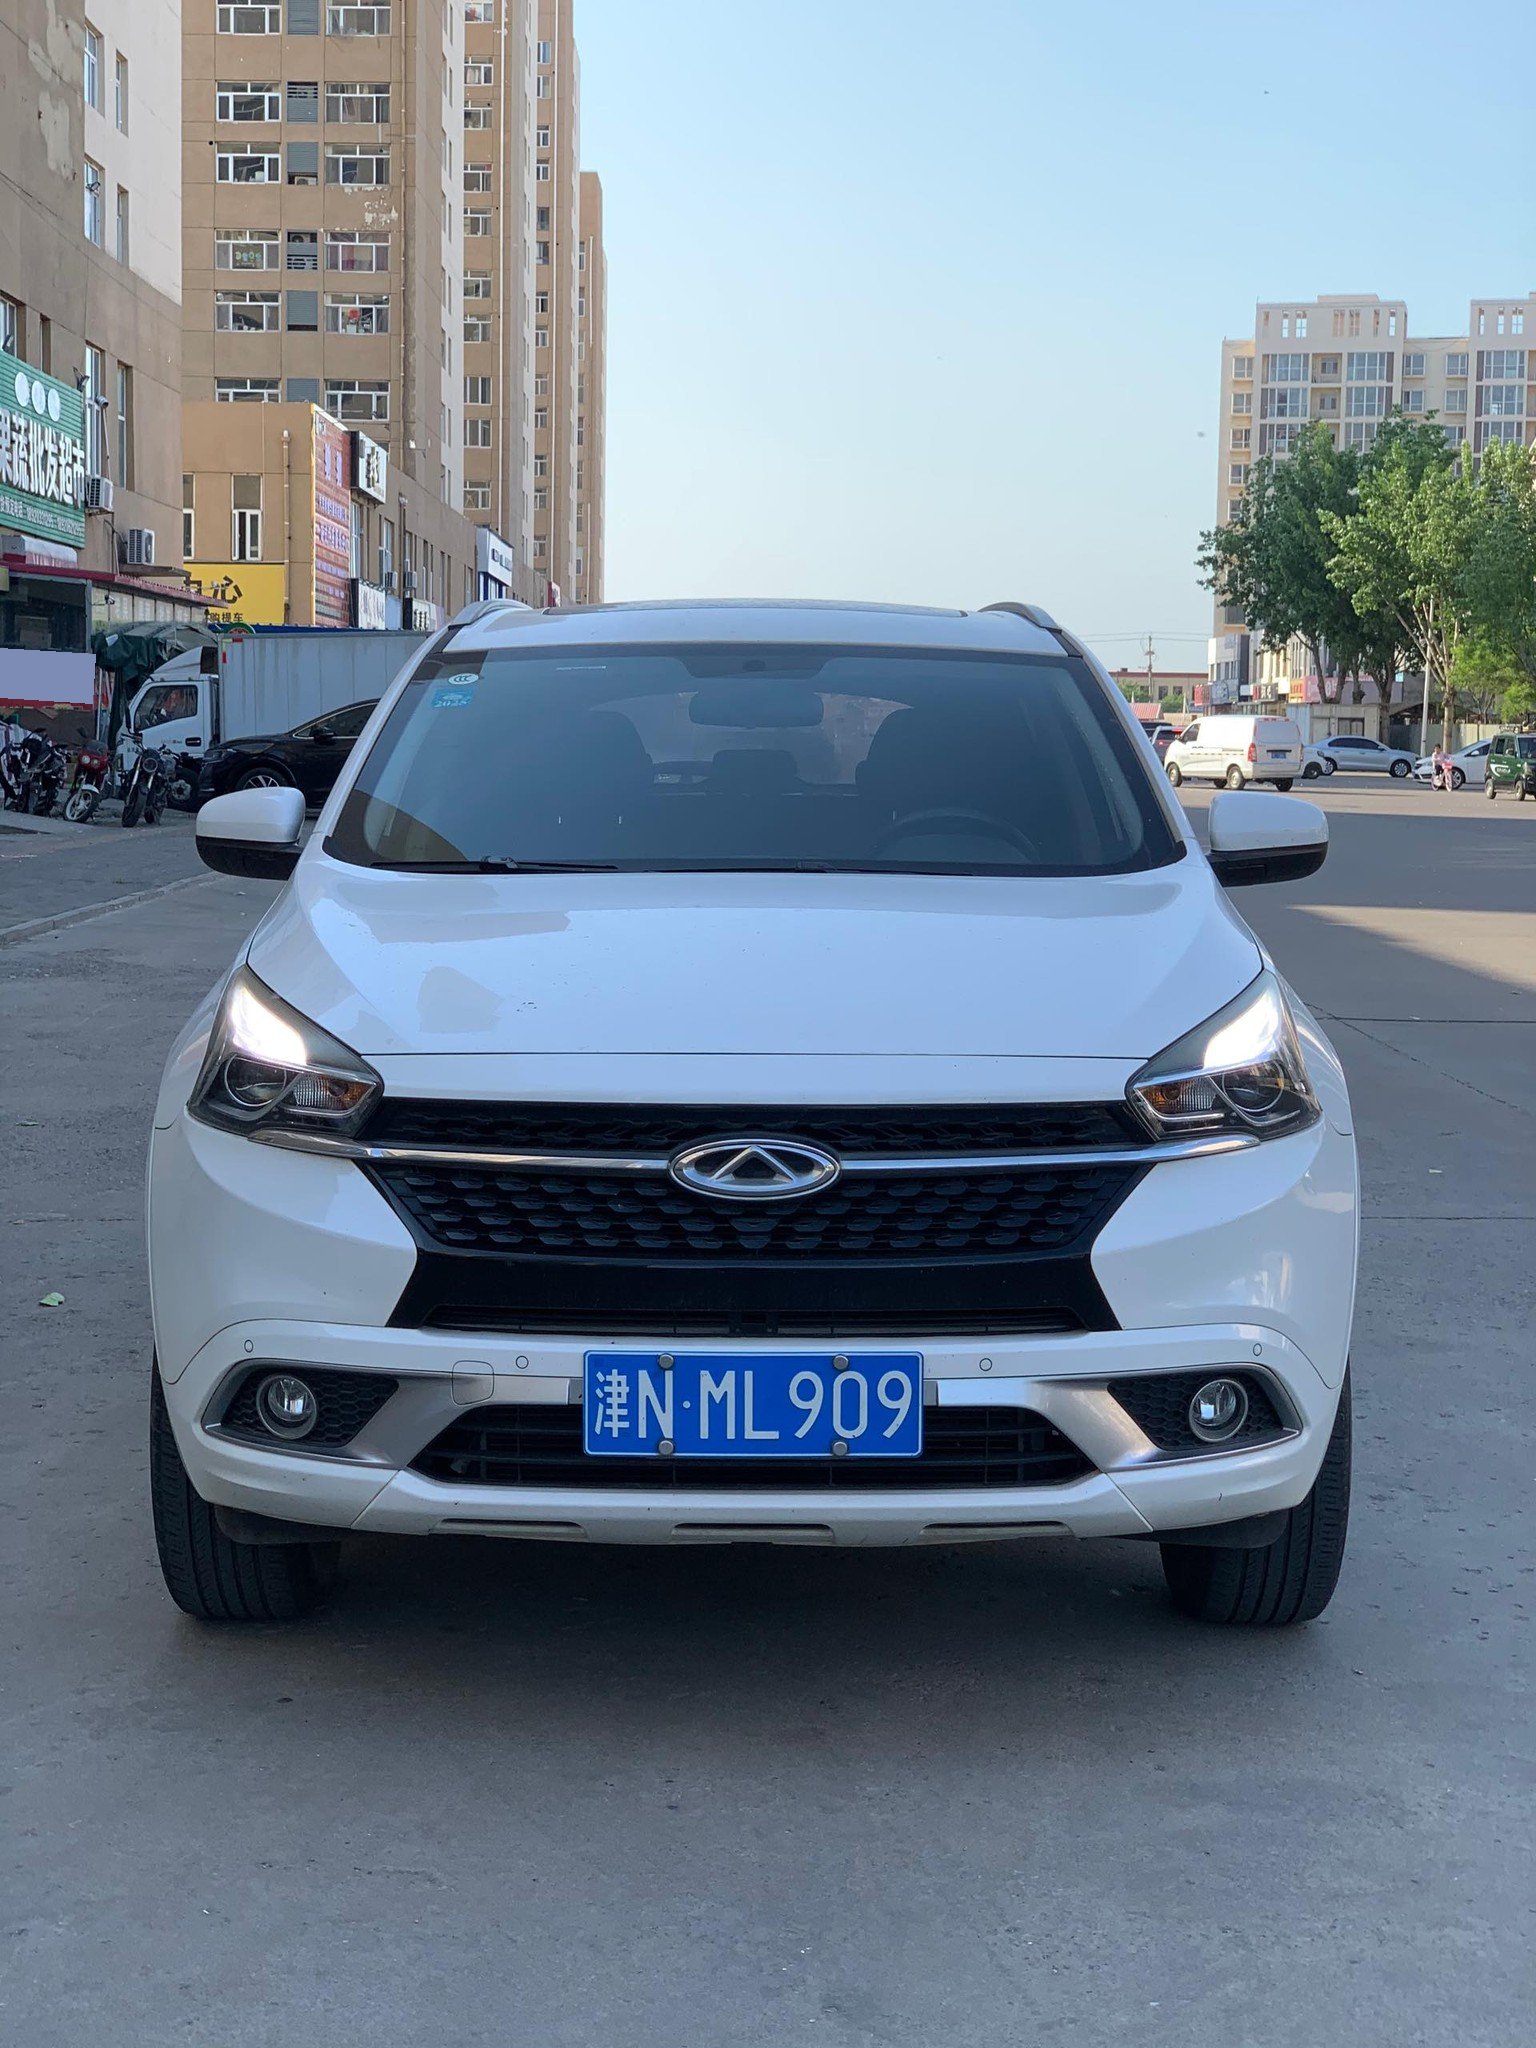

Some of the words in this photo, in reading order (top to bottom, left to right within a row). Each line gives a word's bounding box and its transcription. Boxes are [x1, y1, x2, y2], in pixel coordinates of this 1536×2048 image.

[0, 407, 85, 508] 果蔬批发超市
[594, 1367, 913, 1440] 津N·ML909
